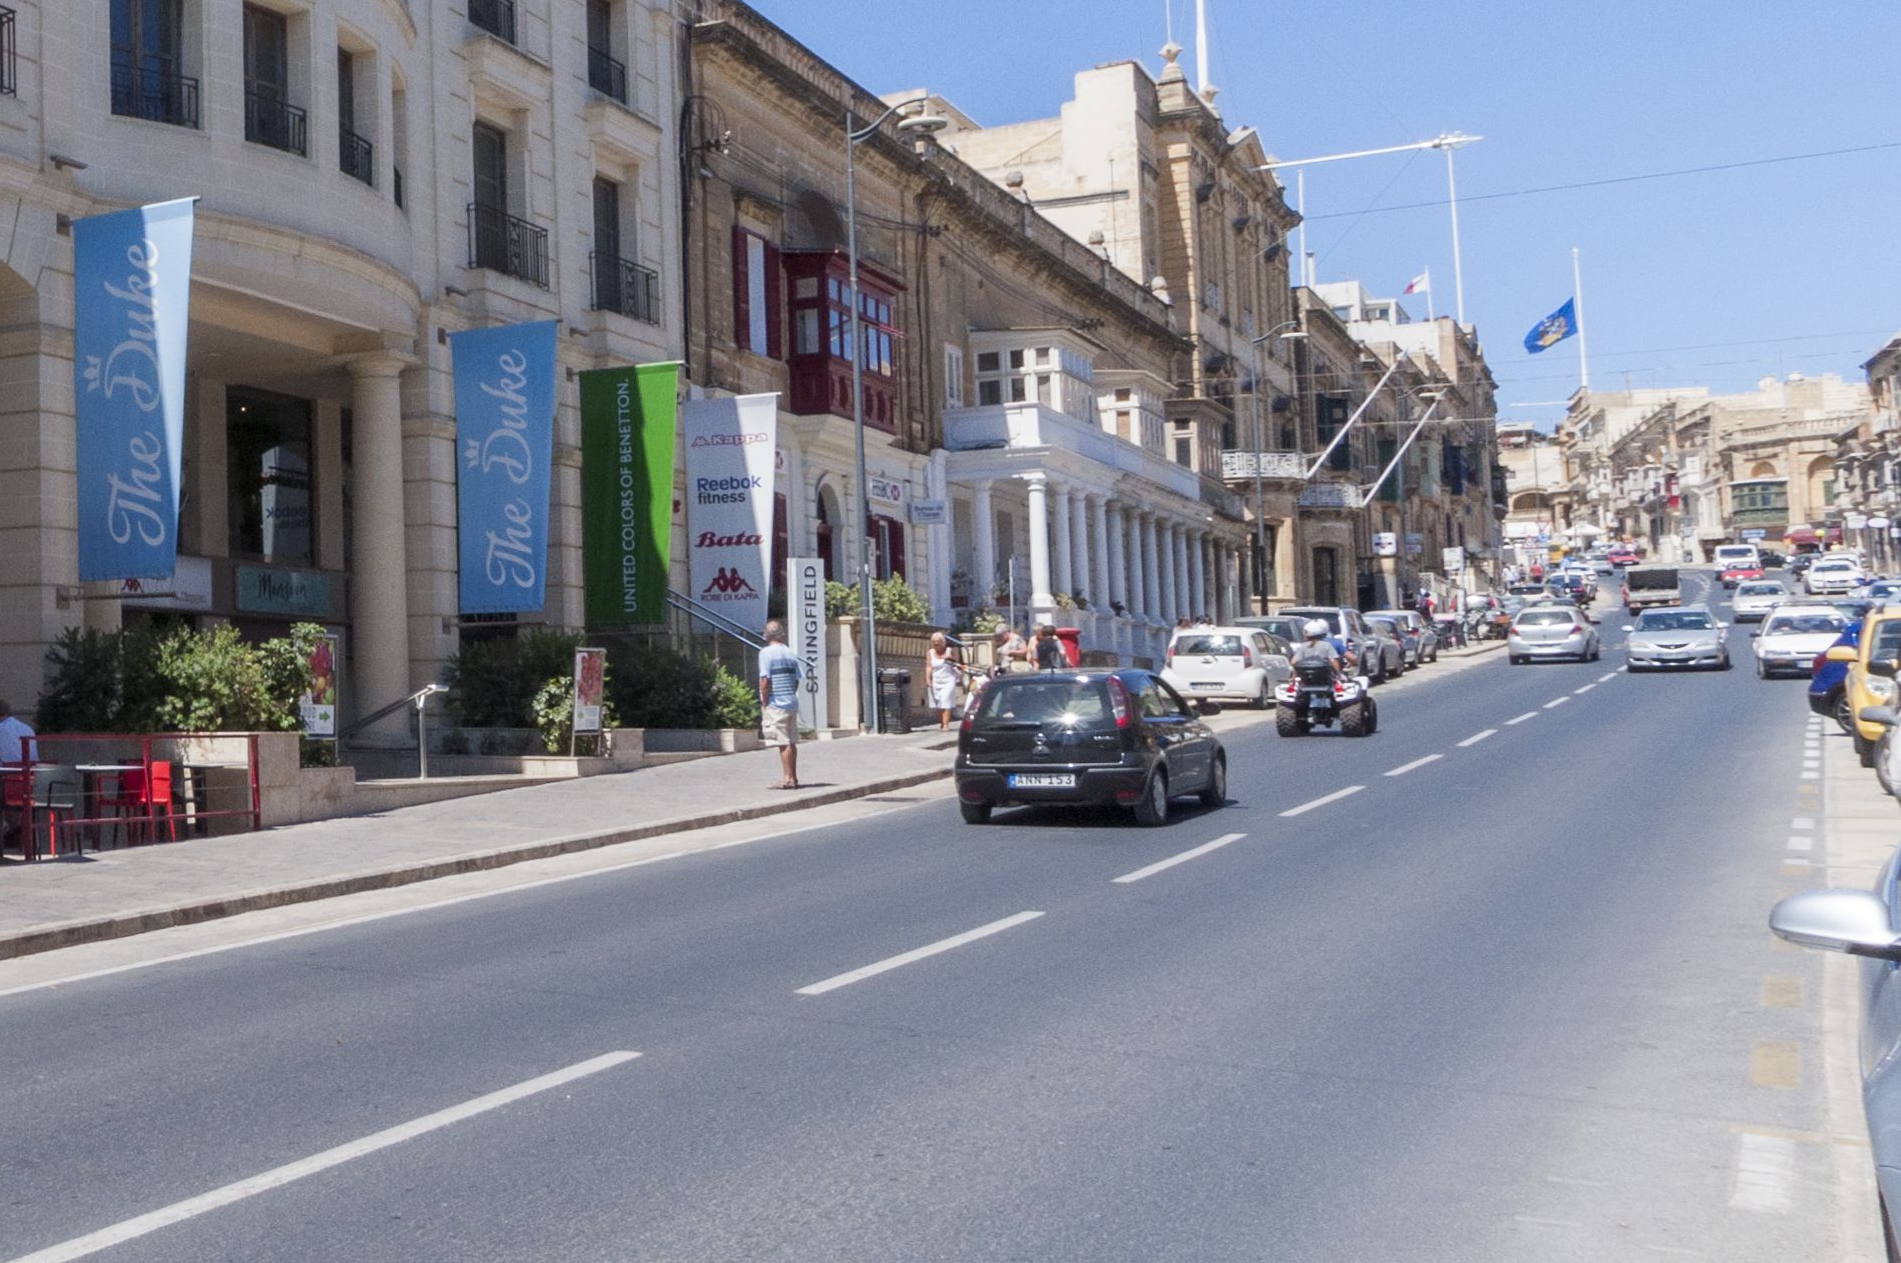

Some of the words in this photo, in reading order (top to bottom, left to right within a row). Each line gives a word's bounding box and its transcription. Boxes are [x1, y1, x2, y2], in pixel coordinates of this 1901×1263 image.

[103, 238, 160, 413] Duke
[480, 348, 533, 485] Duke
[617, 378, 633, 463] BENETTON.
[710, 433, 768, 446] Kappa
[107, 431, 166, 547] The
[620, 466, 634, 488] OF
[697, 475, 762, 491] Reebok
[698, 492, 746, 505] fitness
[486, 498, 536, 588] The
[621, 489, 635, 551] COLORS
[695, 530, 764, 548] Bata
[623, 554, 637, 613] UNITED
[804, 565, 819, 694] SPRINGFIELD
[1017, 774, 1042, 785] ANN
[1047, 774, 1073, 785] 153
